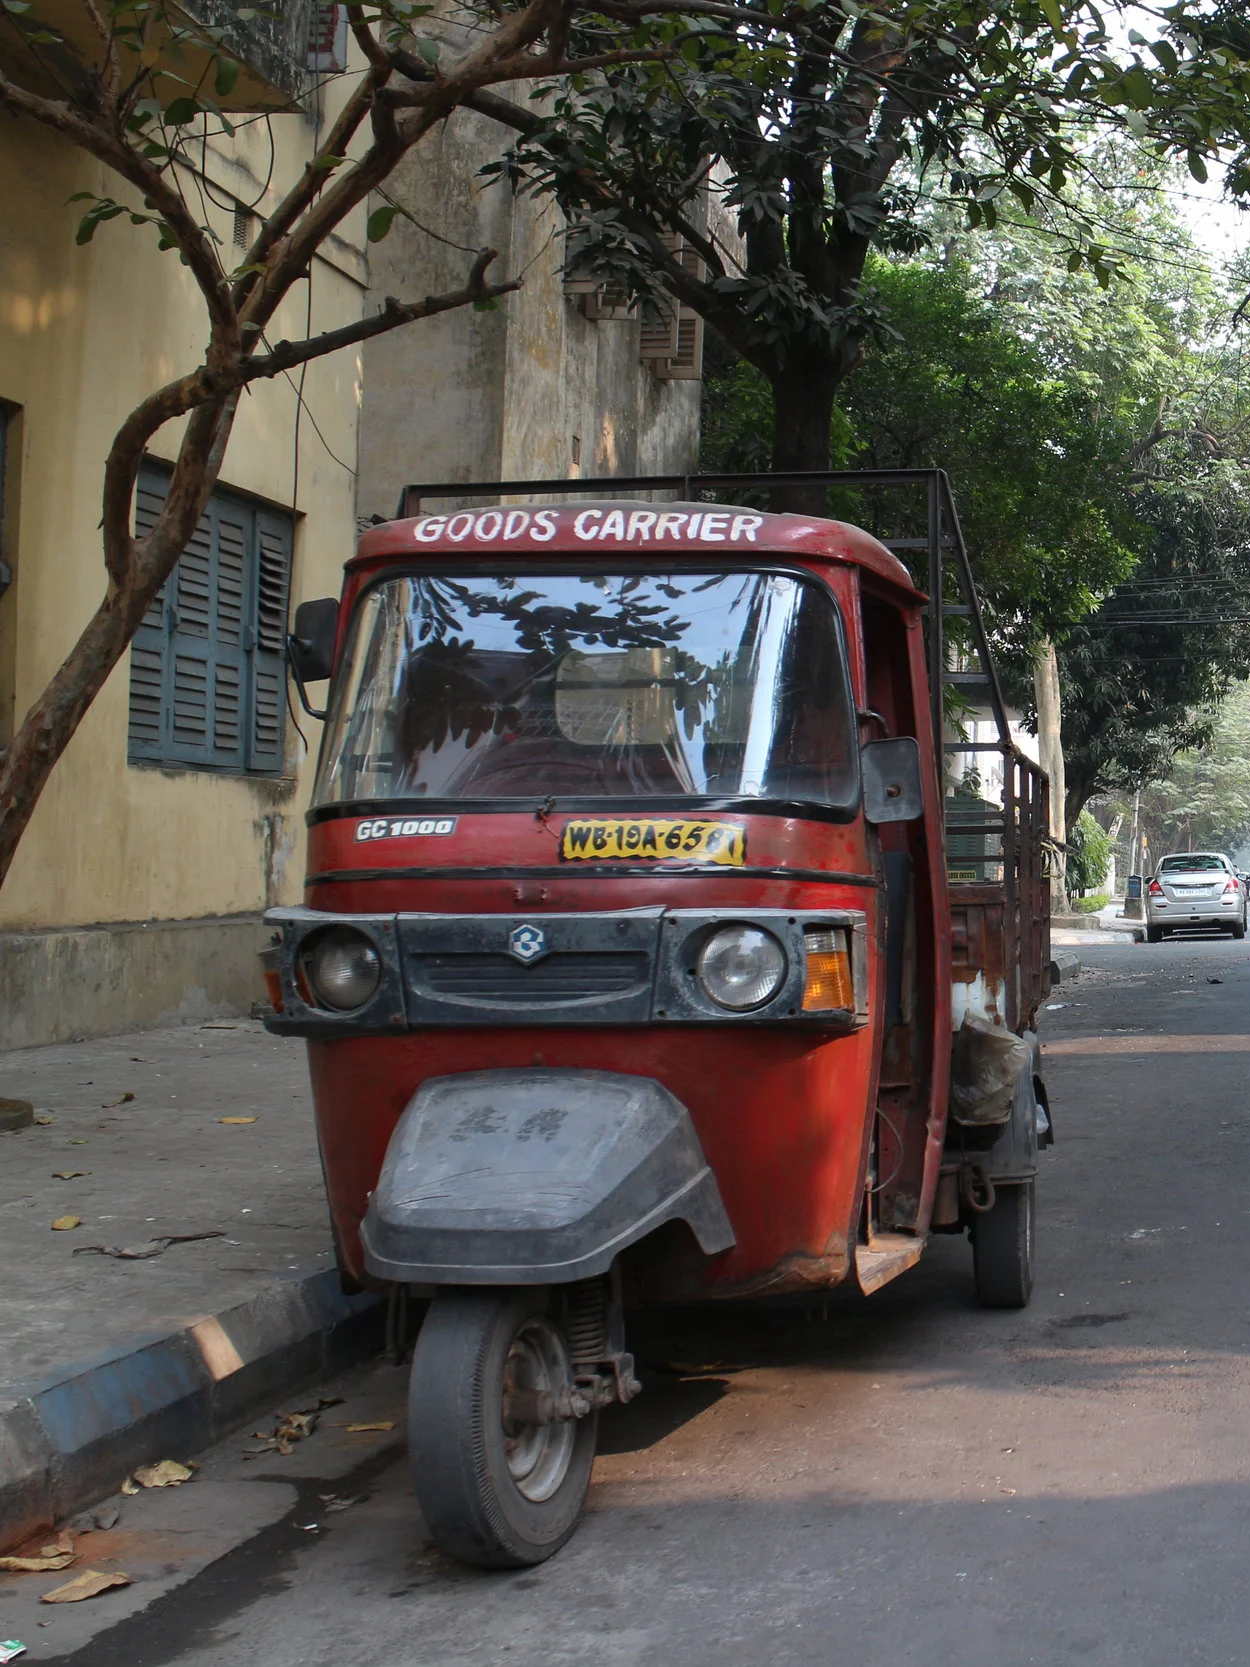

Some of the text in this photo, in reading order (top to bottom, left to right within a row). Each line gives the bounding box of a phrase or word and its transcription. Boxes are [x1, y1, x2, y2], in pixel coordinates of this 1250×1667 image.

[413, 509, 763, 543] GOODS CARRIER
[356, 820, 454, 841] GC 1000
